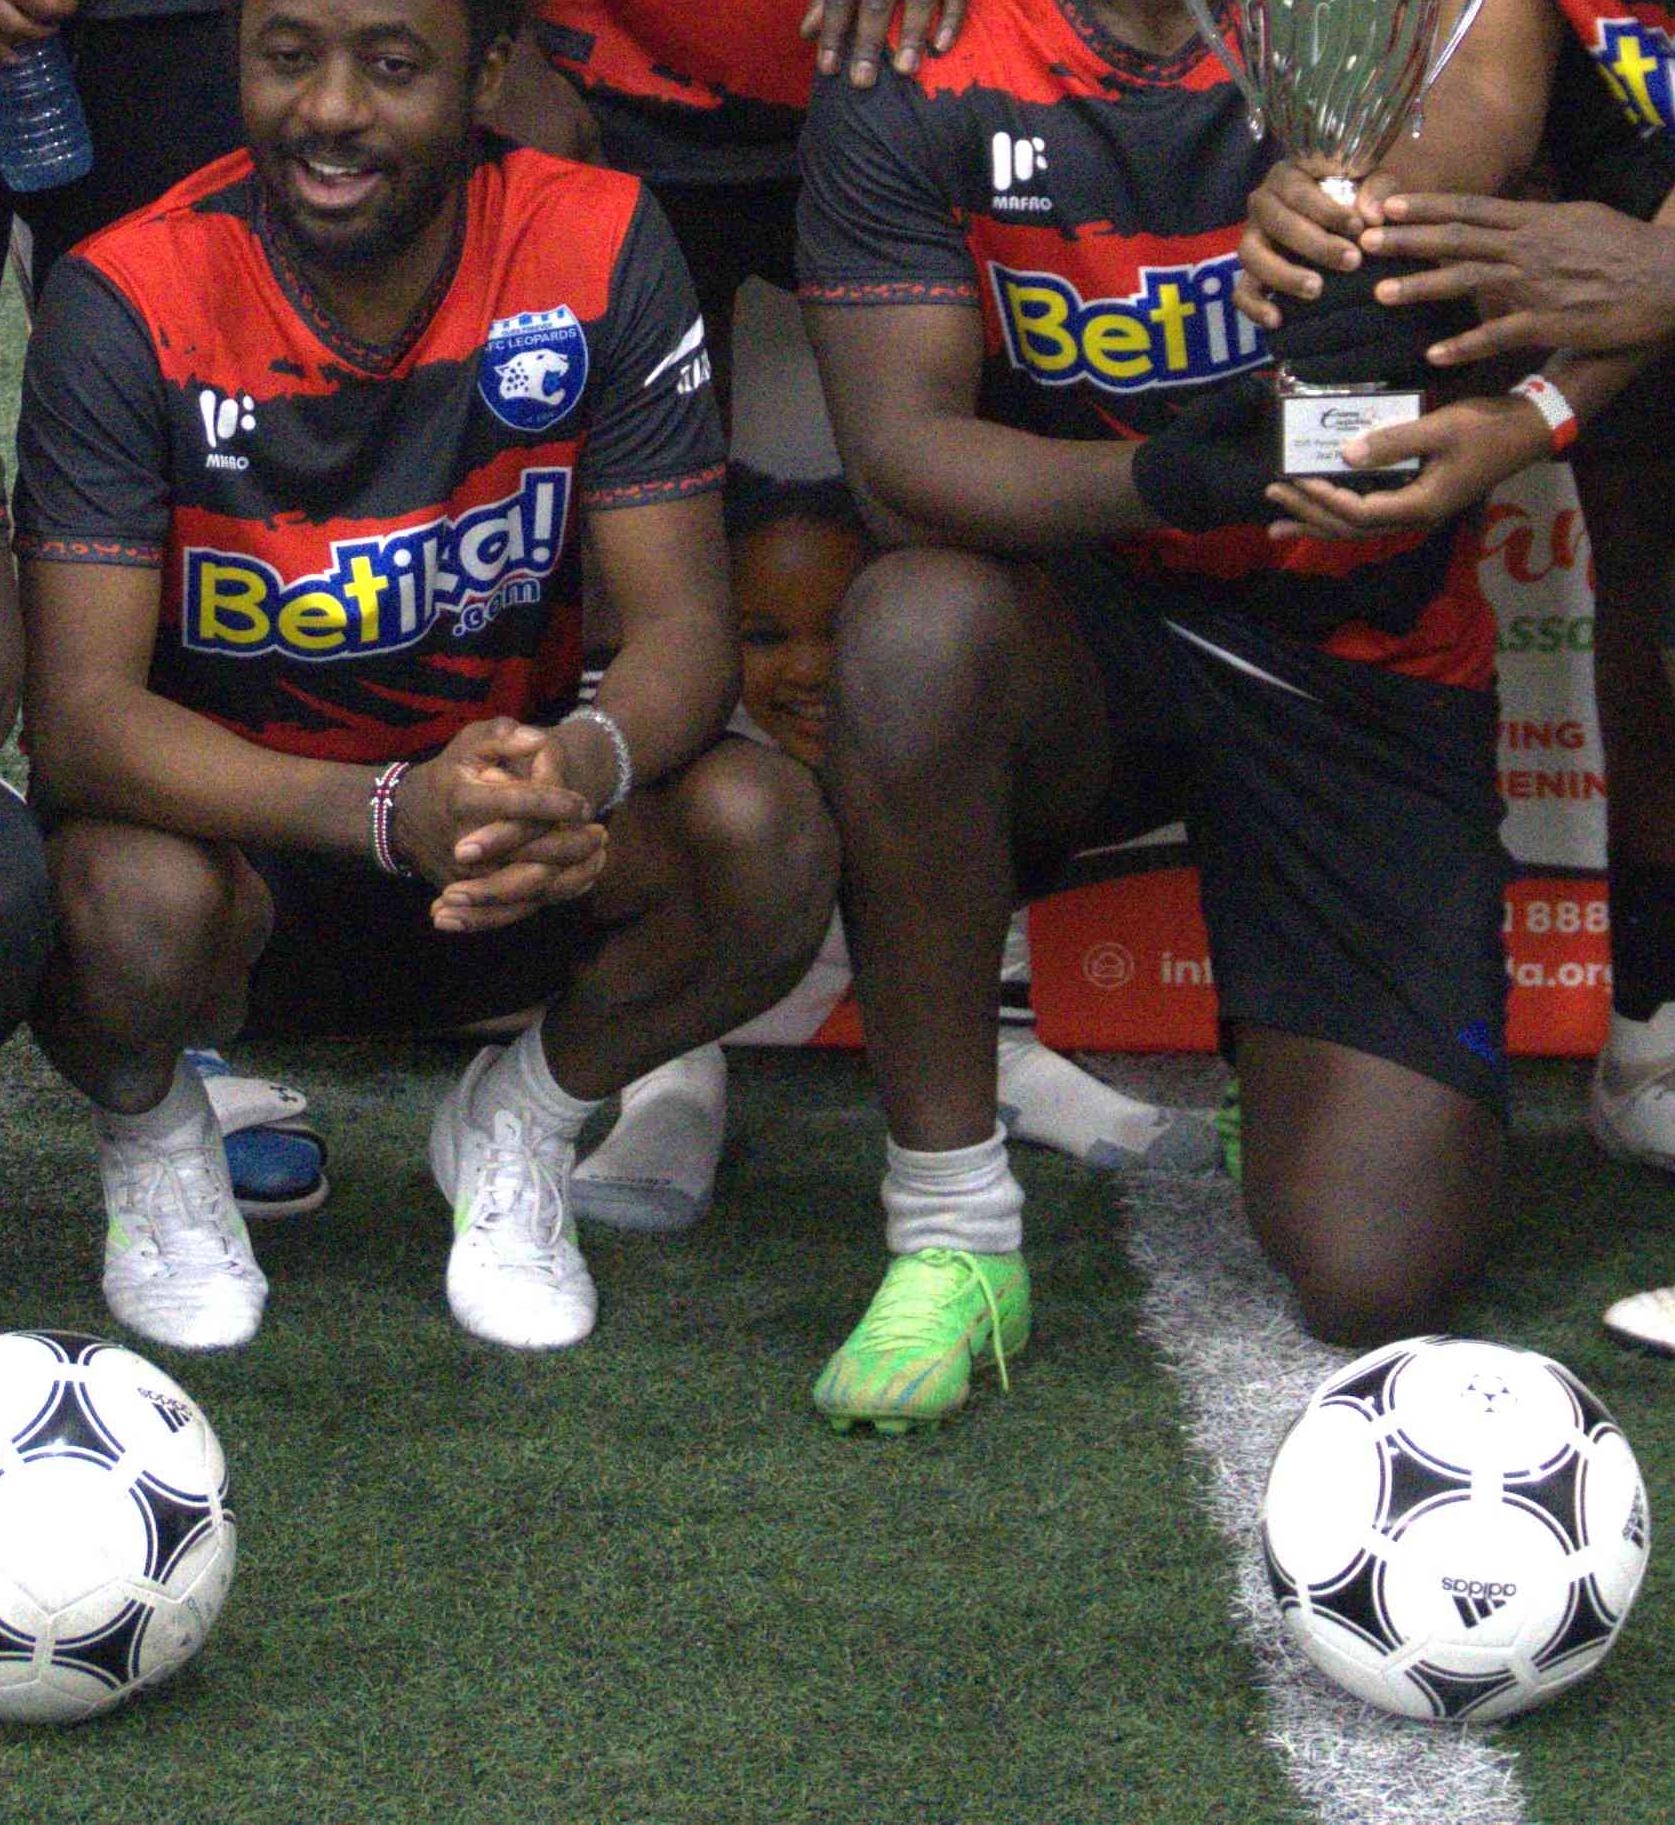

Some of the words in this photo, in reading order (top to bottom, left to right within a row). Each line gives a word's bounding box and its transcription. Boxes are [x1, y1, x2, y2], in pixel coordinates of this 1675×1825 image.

[507, 327, 578, 349] LEOPARDS
[198, 481, 552, 648] Betika!
[1440, 1575, 1519, 1600] adidas
